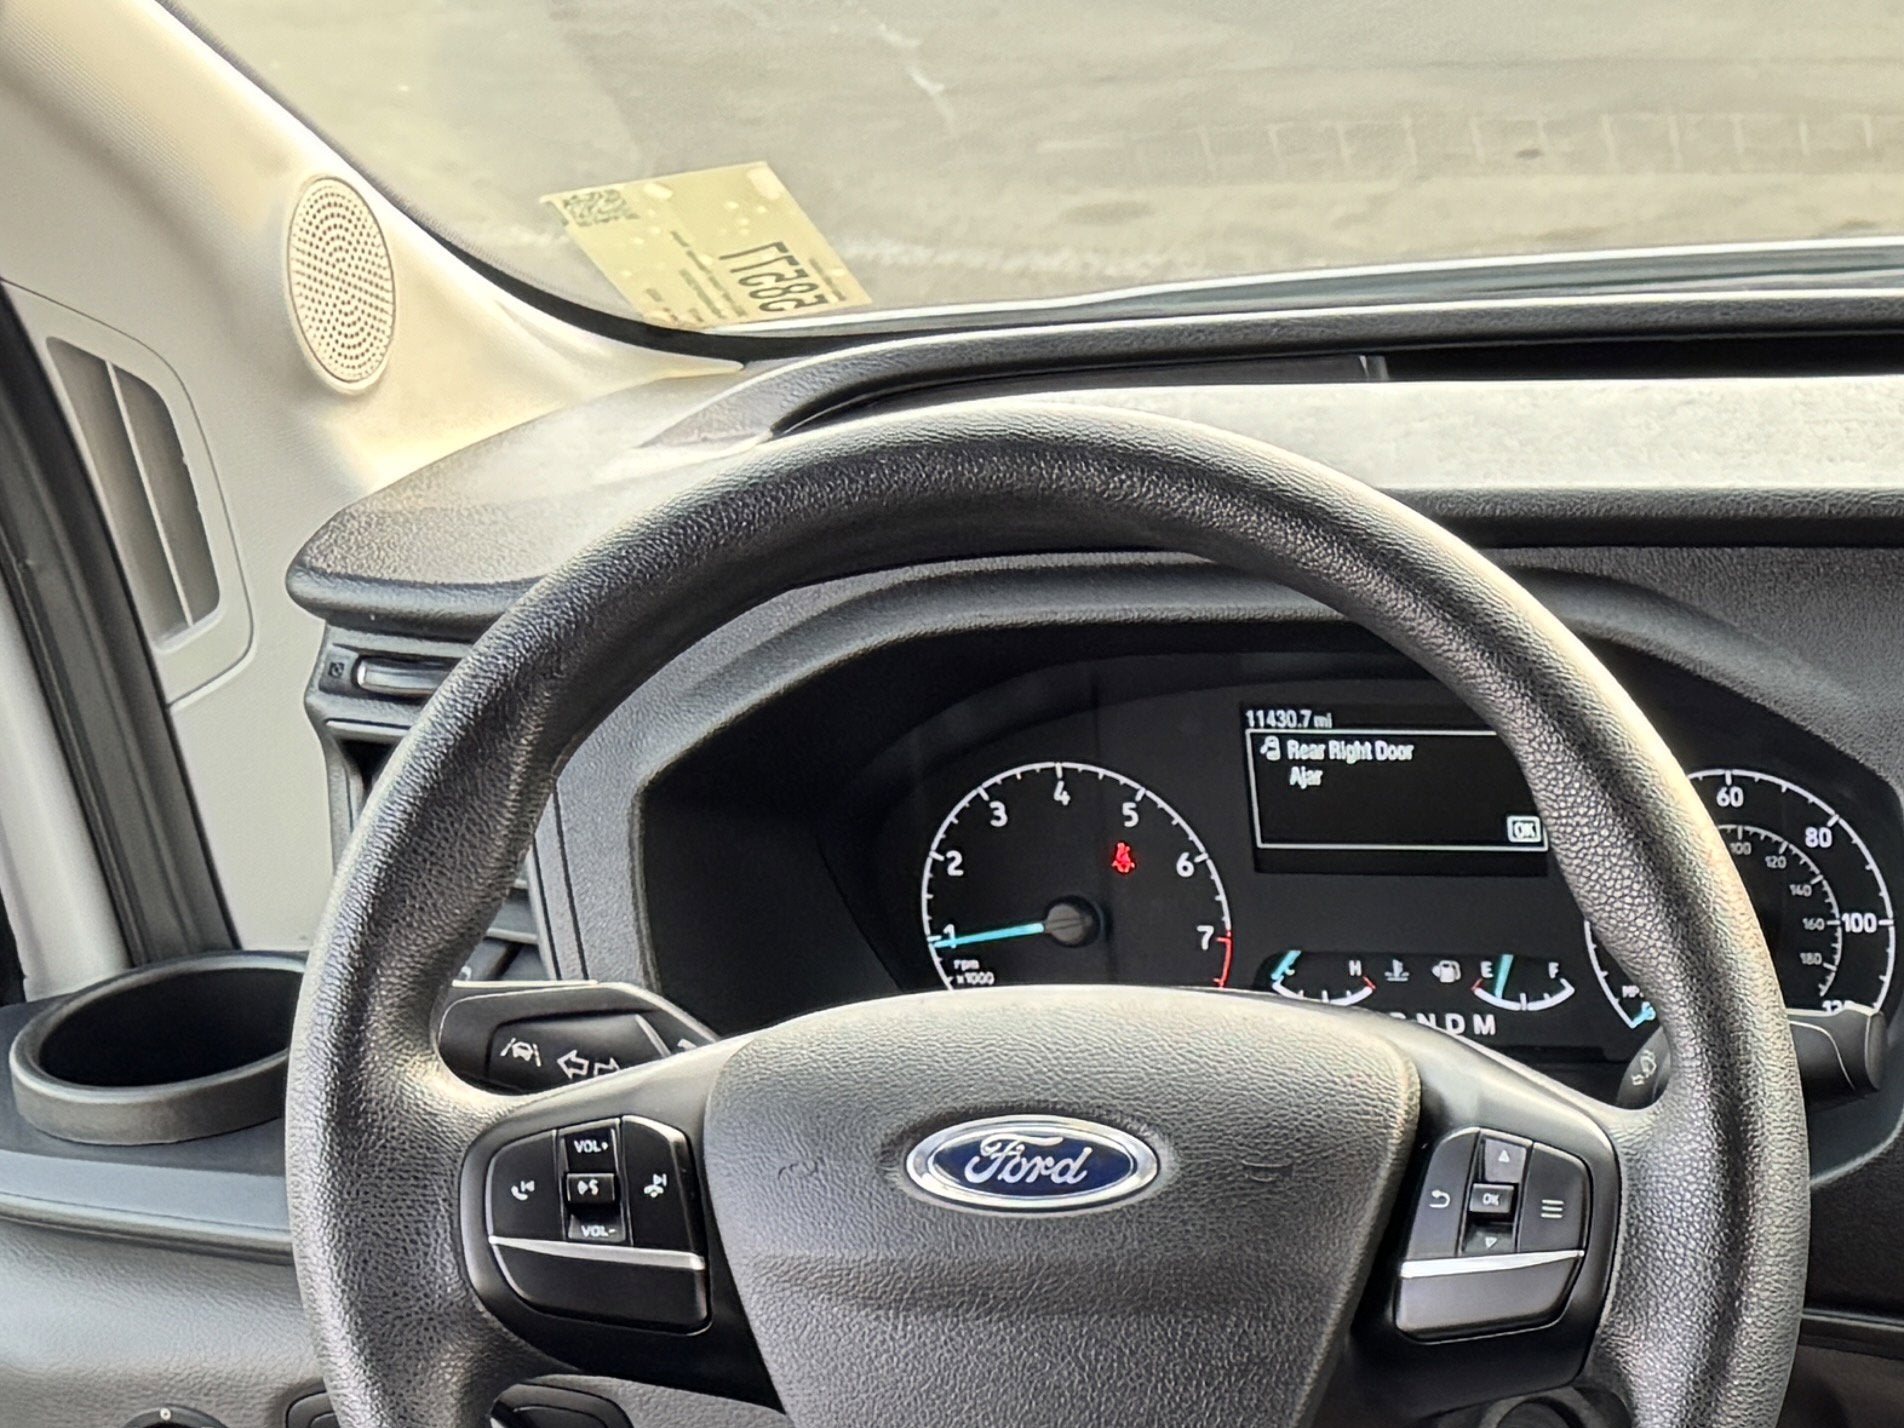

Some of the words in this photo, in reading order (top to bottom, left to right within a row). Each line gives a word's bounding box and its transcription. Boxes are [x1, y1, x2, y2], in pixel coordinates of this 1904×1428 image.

[1246, 709, 1312, 728] 11430.7
[1313, 710, 1333, 729] mi
[1286, 740, 1326, 762] Rear
[1328, 740, 1373, 765] Right
[1375, 741, 1415, 762] Door
[1289, 766, 1324, 789] Ajar
[1053, 780, 1071, 806] 4
[1716, 786, 1745, 808] 60
[989, 801, 1008, 827] 3
[1122, 802, 1140, 827] 5
[1512, 822, 1536, 839] OK
[1804, 826, 1833, 849] 80
[1730, 841, 1752, 855] 100
[946, 850, 964, 876] 2
[1175, 852, 1195, 878] 6
[1765, 855, 1787, 869] 120
[1789, 883, 1813, 897] 140
[1802, 917, 1825, 931] 160
[1841, 912, 1878, 934] 100
[1196, 925, 1214, 950] 7
[953, 959, 980, 972] rpm
[1349, 960, 1362, 976] H
[1481, 961, 1493, 978] E
[1800, 952, 1823, 966] 180
[1549, 962, 1559, 978] F
[1621, 985, 1644, 998] MP
[1444, 1012, 1465, 1035] D
[1473, 1013, 1496, 1035] M
[964, 1133, 1092, 1184] Ford
[1482, 1192, 1500, 1207] OK
